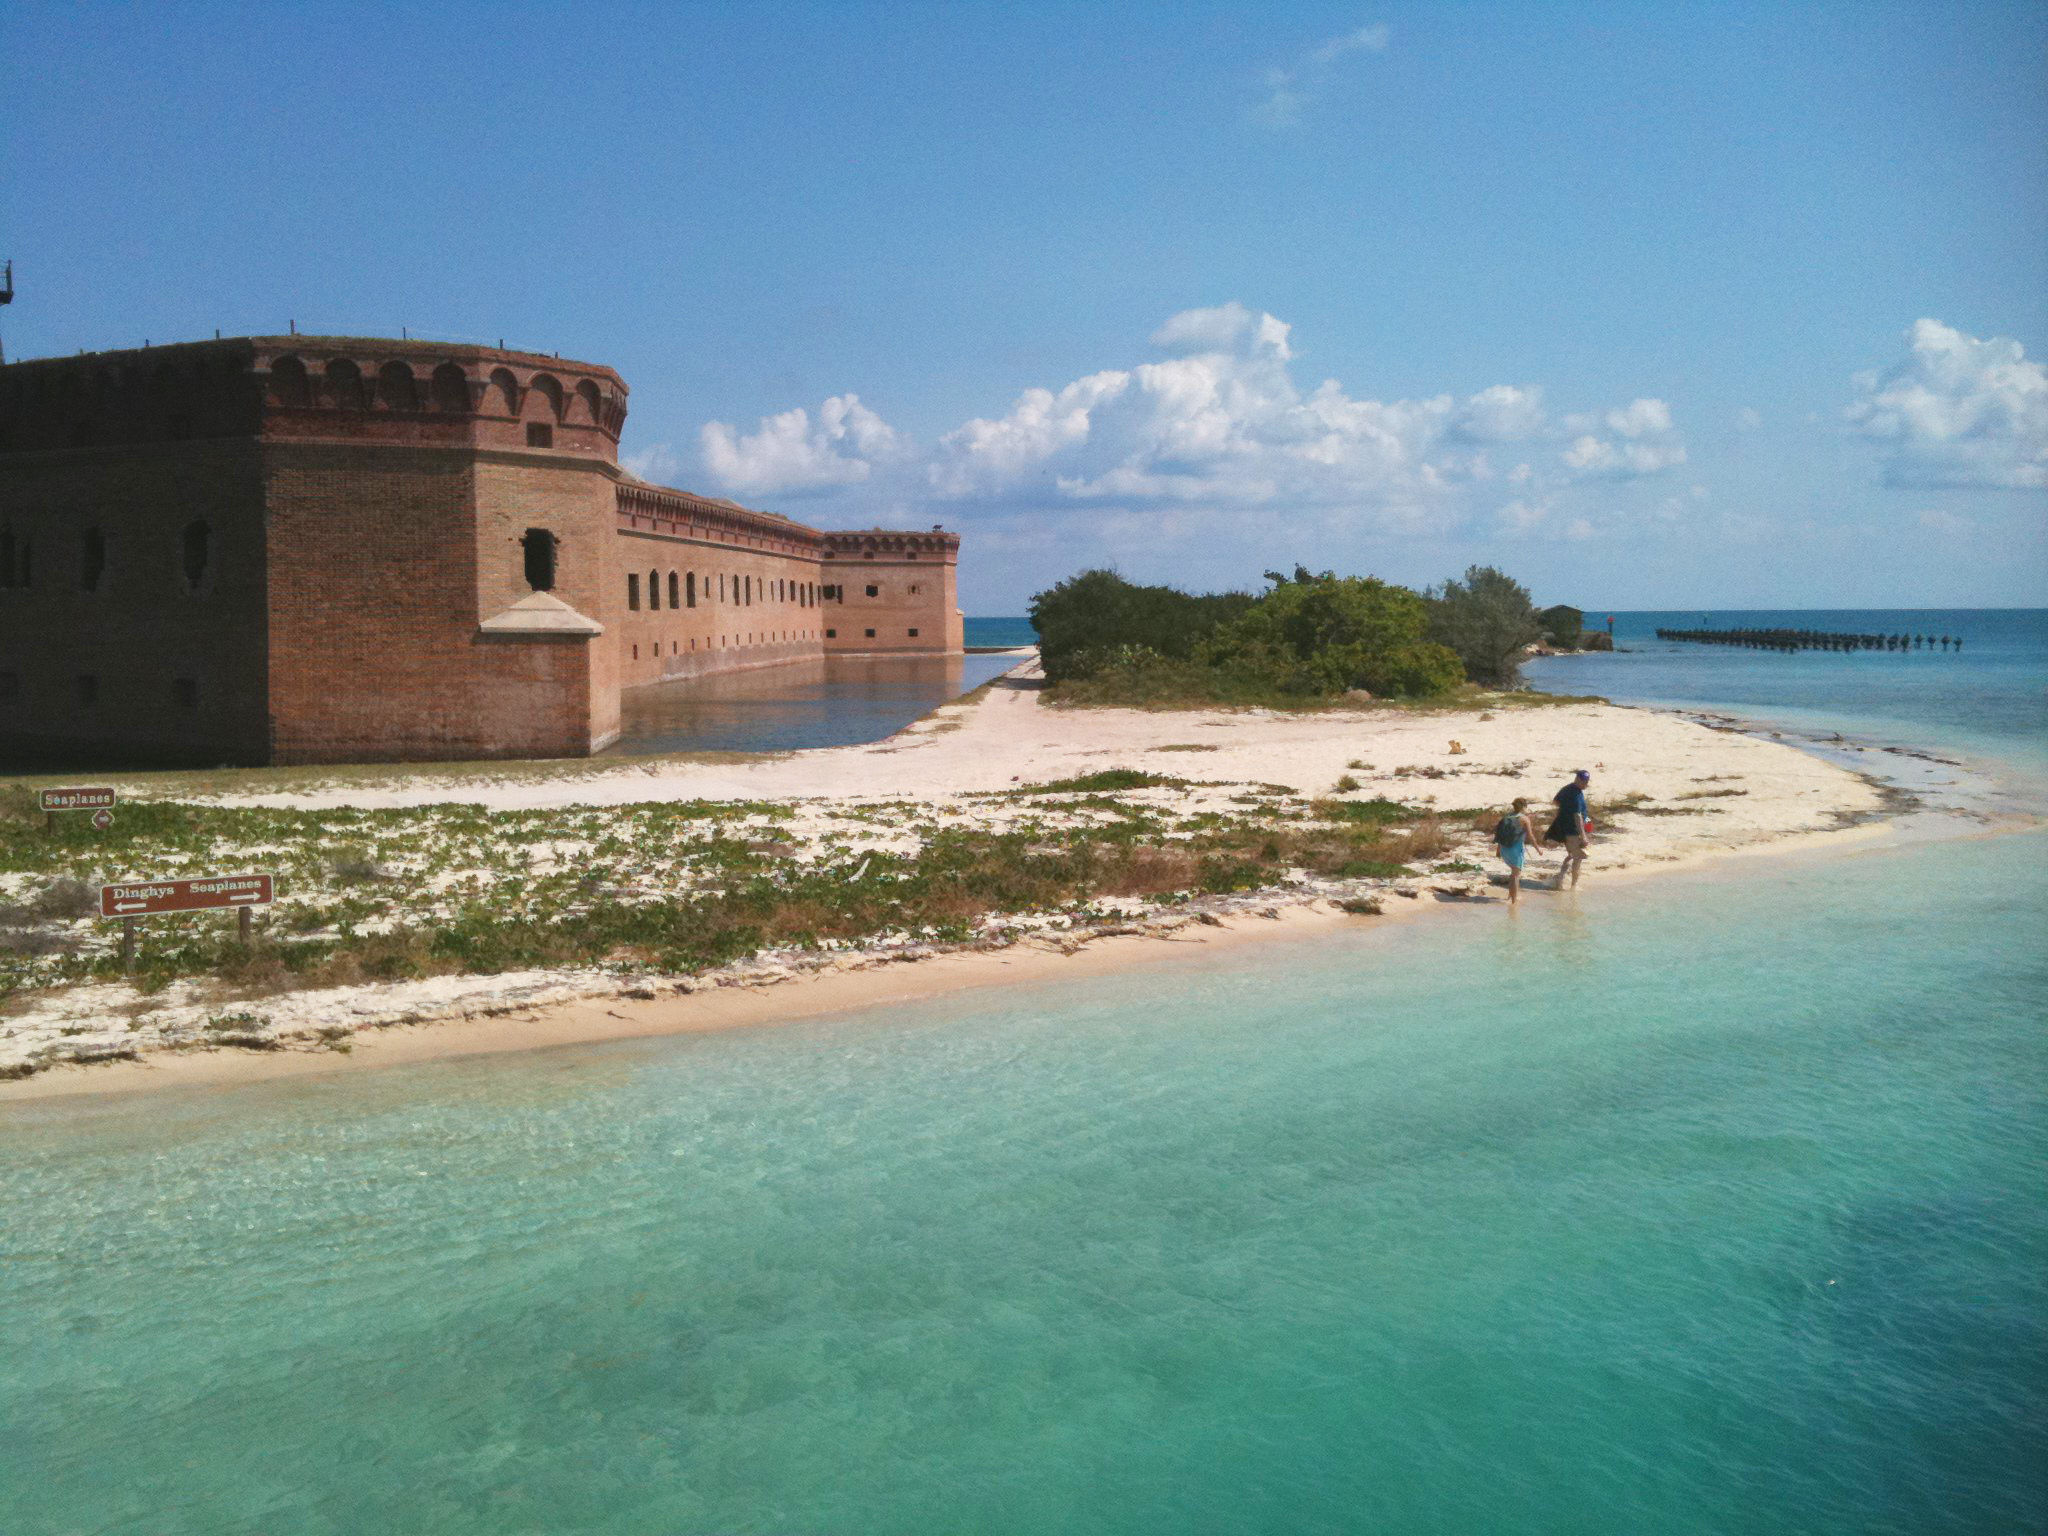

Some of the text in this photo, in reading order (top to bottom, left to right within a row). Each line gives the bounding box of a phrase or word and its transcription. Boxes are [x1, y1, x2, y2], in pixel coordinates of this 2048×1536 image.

[45, 793, 110, 807] Seaplanes
[113, 880, 262, 901] Dinghys Seaplanes
